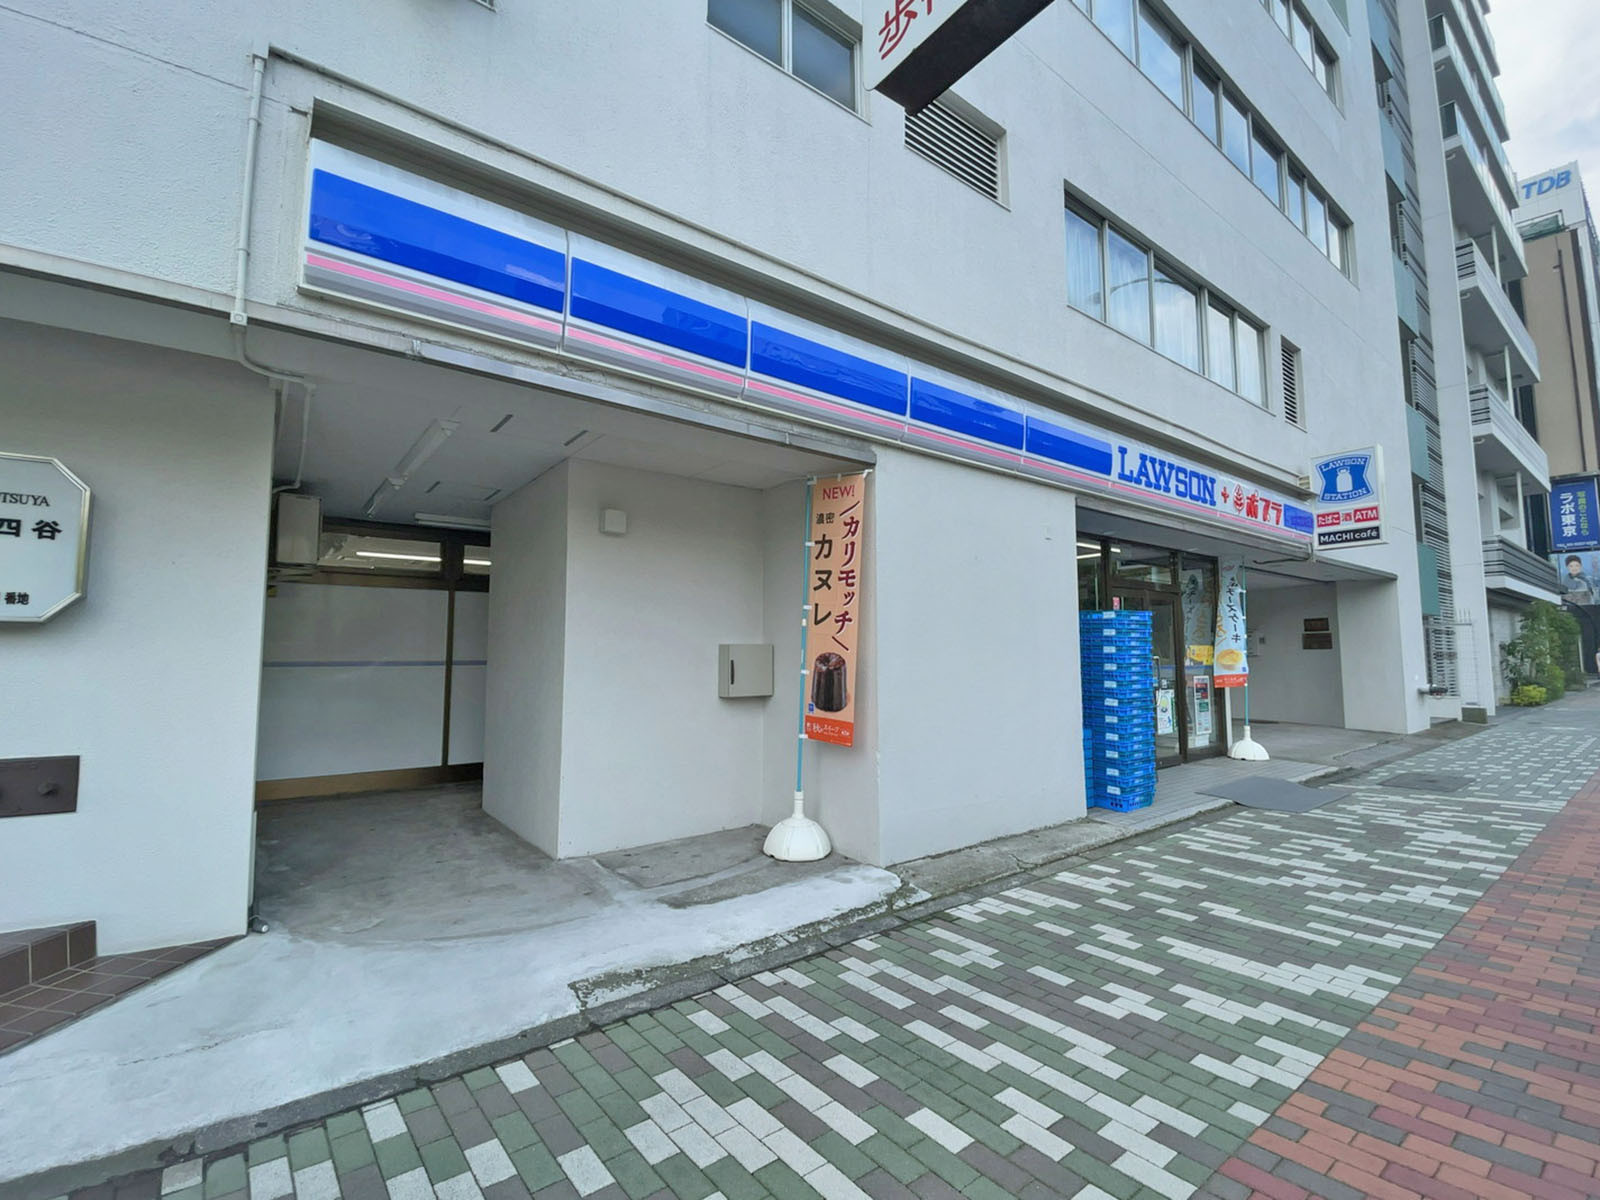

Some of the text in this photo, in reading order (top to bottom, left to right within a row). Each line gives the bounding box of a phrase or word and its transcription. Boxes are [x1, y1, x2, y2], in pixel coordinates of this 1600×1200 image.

[1521, 170, 1571, 200] TDB
[1118, 445, 1217, 507] LAWSON
[1321, 458, 1367, 472] LAWSON
[822, 485, 855, 501] NEW!
[1323, 487, 1368, 500] STATION
[1355, 509, 1378, 521] ATM
[813, 533, 833, 626] カヌレ
[834, 516, 859, 635] カリモッチ
